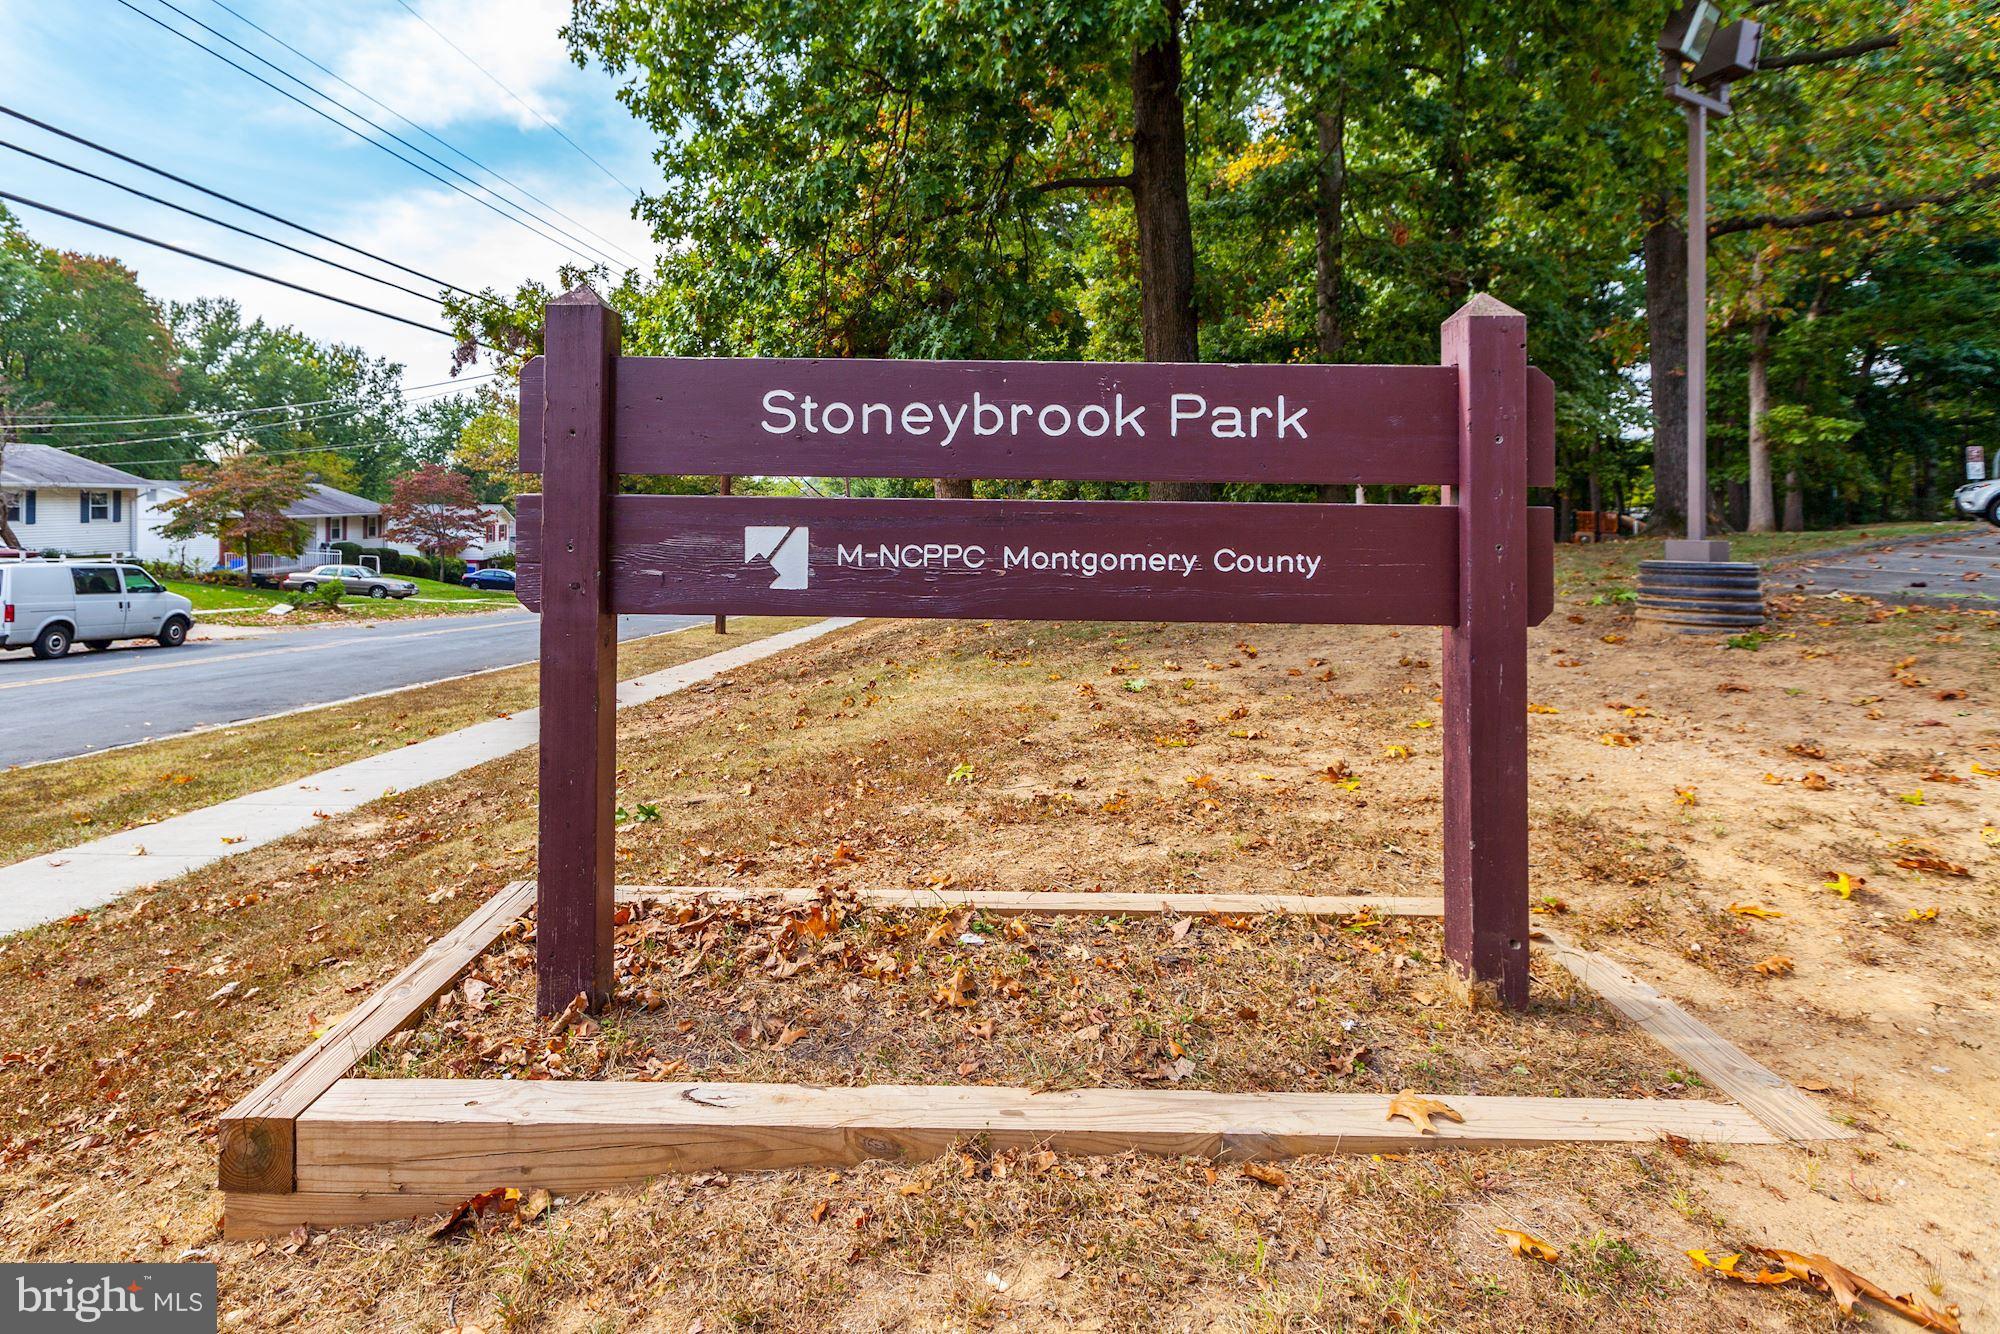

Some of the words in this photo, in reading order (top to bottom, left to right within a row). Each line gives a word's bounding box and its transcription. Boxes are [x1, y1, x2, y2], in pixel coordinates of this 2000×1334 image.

[761, 389, 1147, 448] Stoneybrook
[1170, 393, 1309, 440] Park
[836, 543, 987, 569] M-NCPPC
[1003, 545, 1199, 579] Montgomery
[1213, 548, 1323, 580] County
